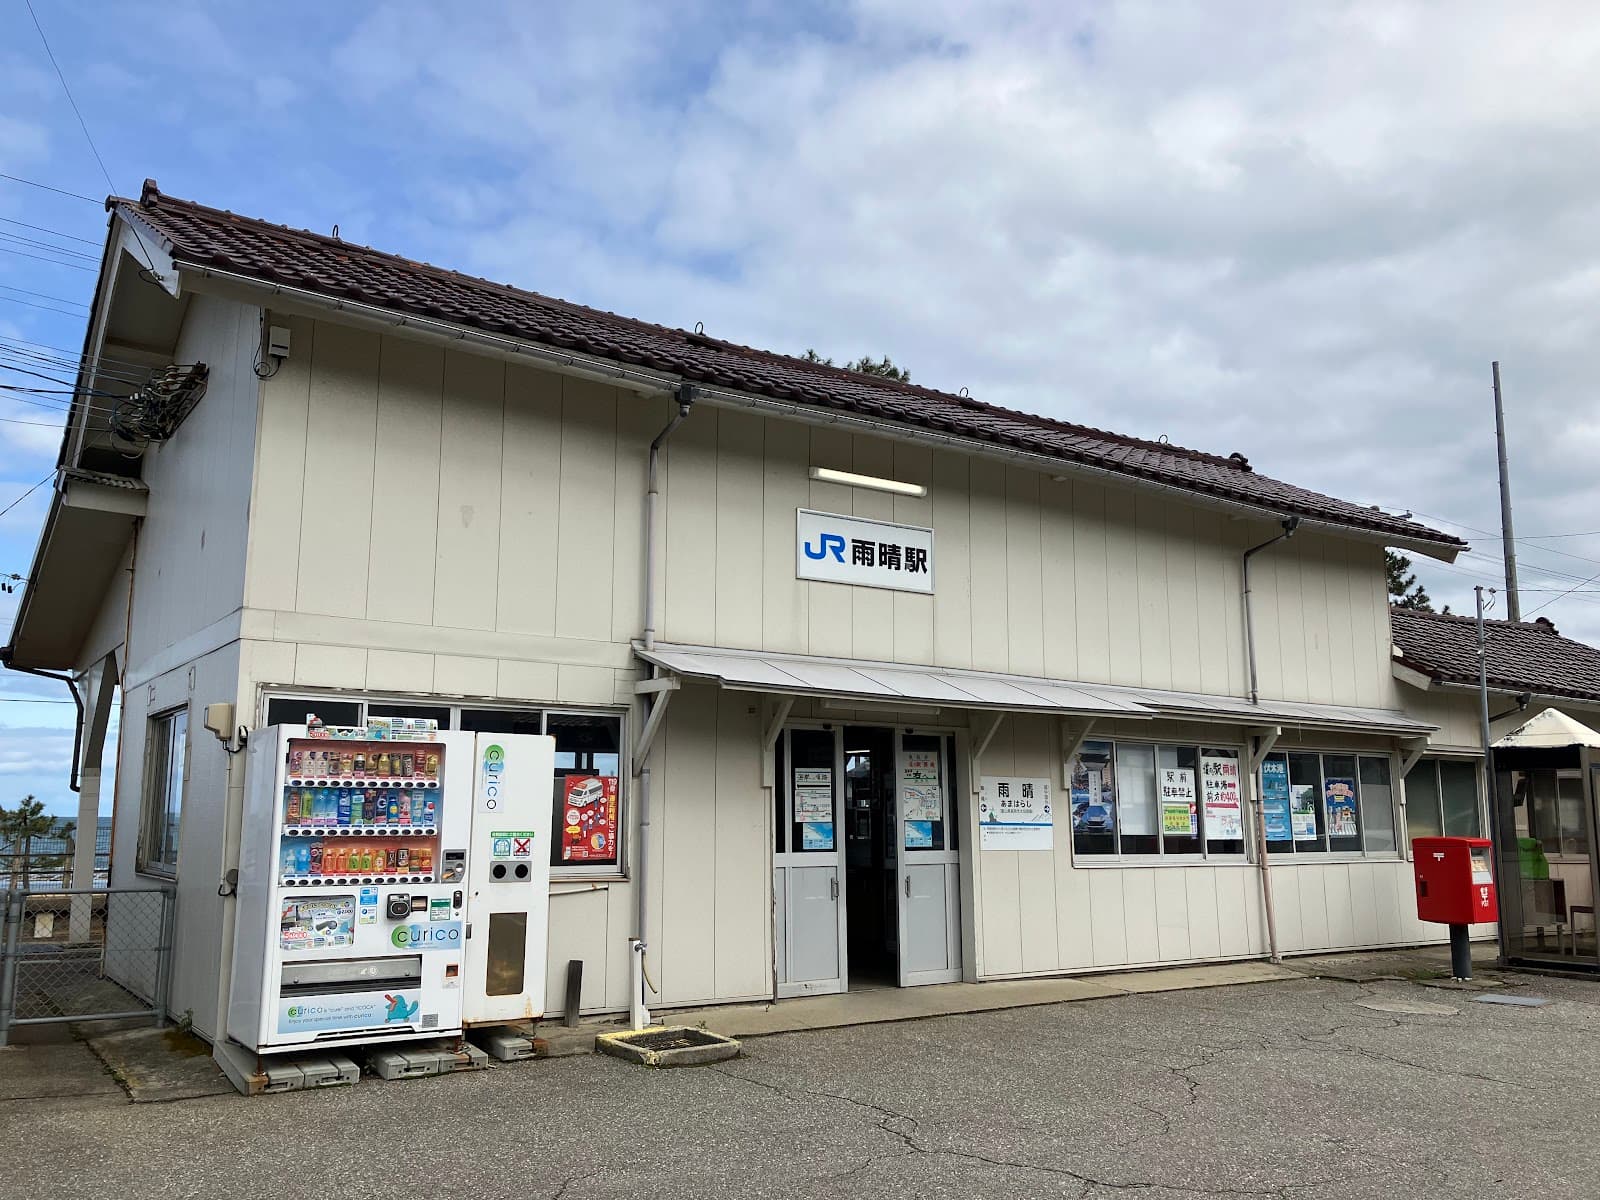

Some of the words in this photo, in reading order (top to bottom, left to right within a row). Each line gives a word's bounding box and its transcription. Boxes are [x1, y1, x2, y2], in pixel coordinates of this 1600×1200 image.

[804, 533, 846, 563] JR
[851, 538, 928, 574] 雨晴駅
[486, 749, 501, 810] curico
[997, 782, 1034, 799] 雨晴
[1000, 799, 1032, 808] あまはらし
[397, 926, 460, 944] curico
[288, 1006, 323, 1017] curico
